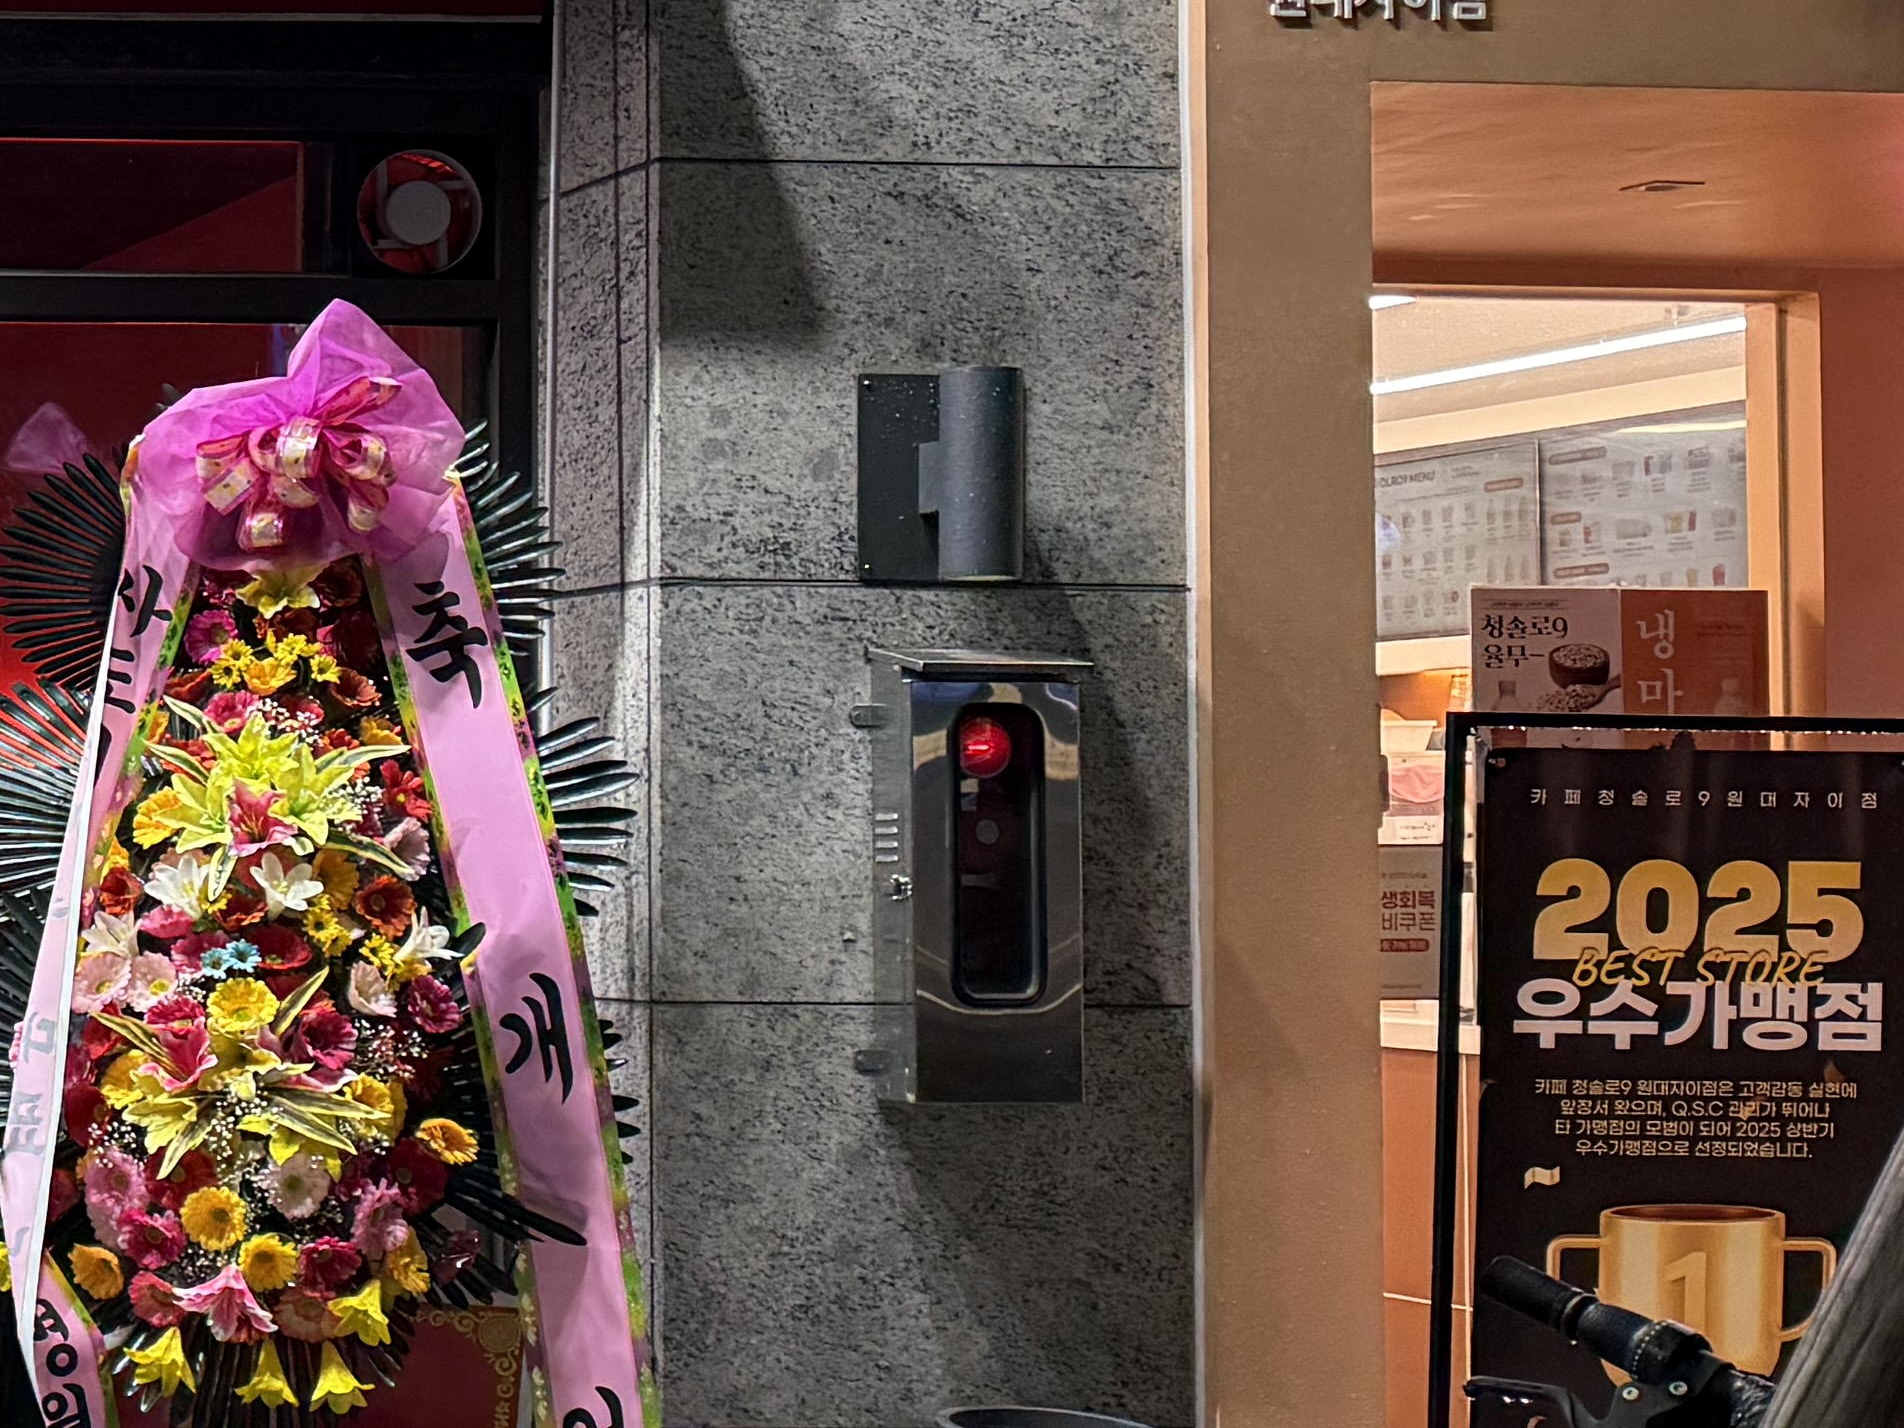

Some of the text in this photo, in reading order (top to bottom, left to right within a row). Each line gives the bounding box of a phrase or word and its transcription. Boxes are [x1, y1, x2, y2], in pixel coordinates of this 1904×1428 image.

[407, 579, 488, 708] 축
[1533, 857, 1864, 963] 2025
[1572, 946, 1828, 987] BEST STORE
[1513, 978, 1883, 1051] 우수가맹점
[1535, 1078, 1567, 1095] 카페
[1637, 1079, 1733, 1097] 원대자이점은
[1739, 1081, 1803, 1098] 고객감동
[1561, 1099, 1608, 1115] 앞장서
[1672, 1100, 1723, 1117] Q.S.C
[1782, 1102, 1830, 1118] 뛰어나
[1576, 1119, 1640, 1135] 가맹점의
[1645, 1120, 1693, 1136] 모범이
[1699, 1121, 1731, 1137] 되어
[1736, 1122, 1781, 1137] 2025
[1786, 1122, 1834, 1139] 상반기
[1576, 1139, 1813, 1158] 우수가맹점으로 선정되었습니다.
